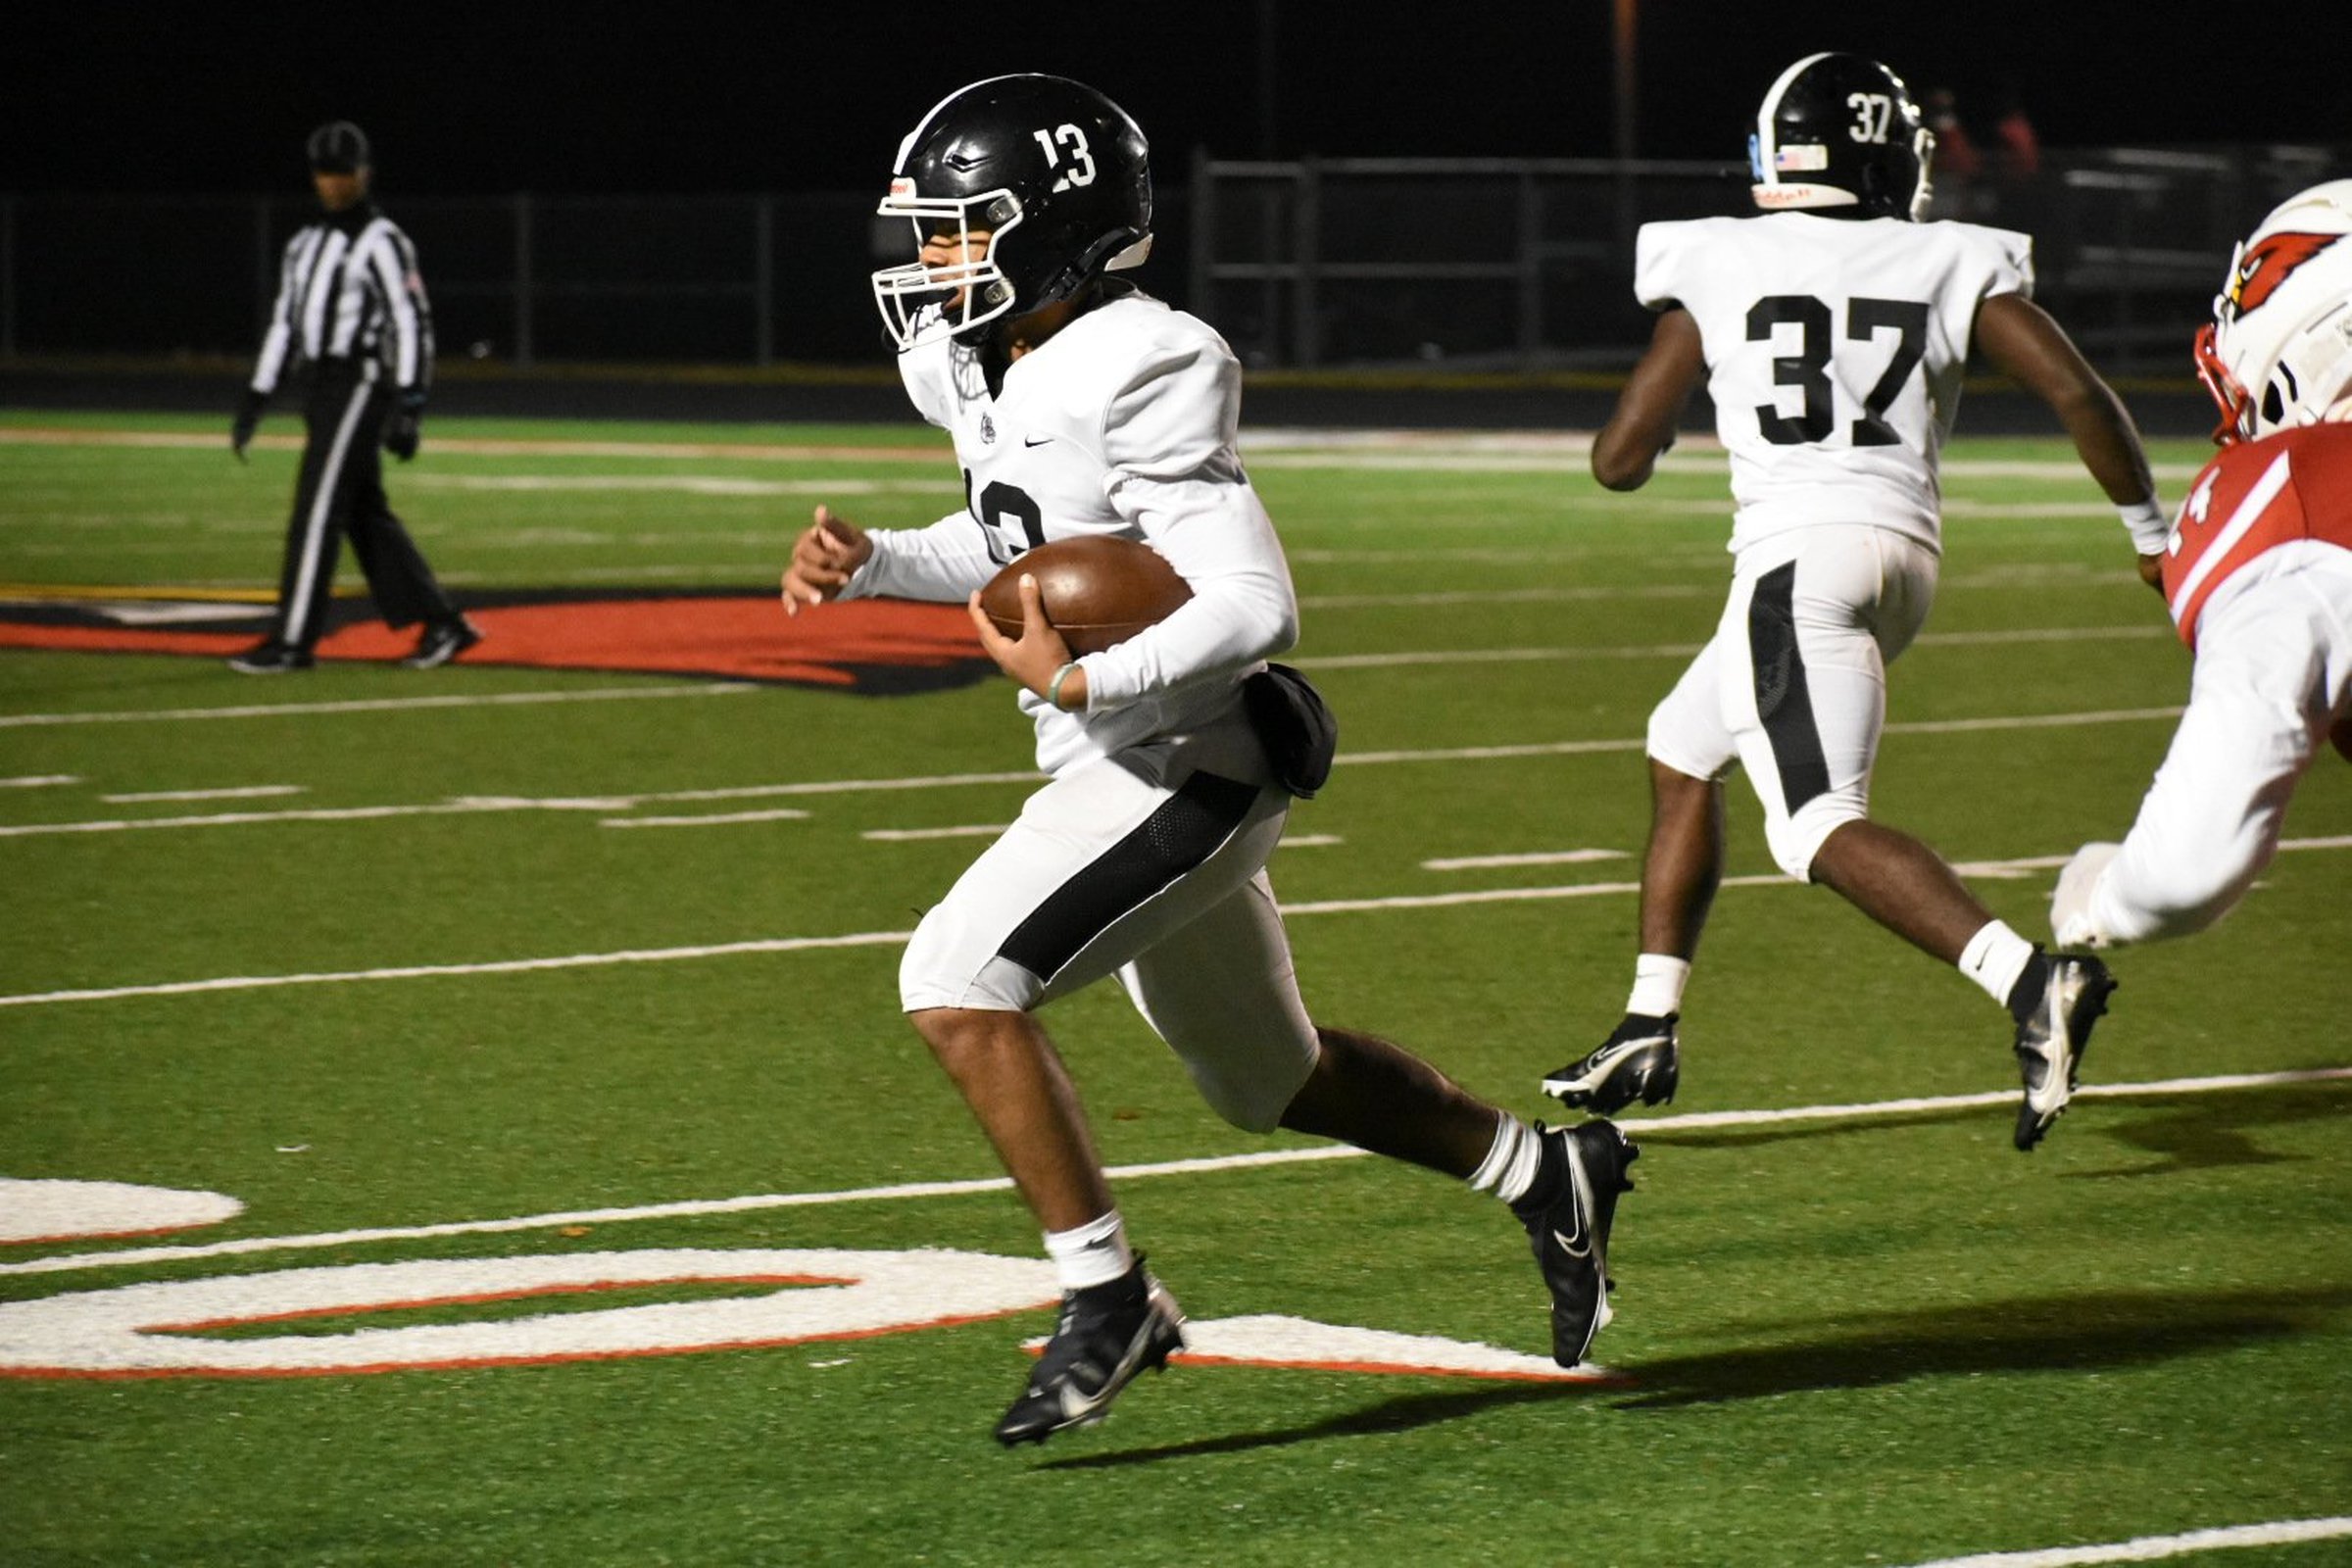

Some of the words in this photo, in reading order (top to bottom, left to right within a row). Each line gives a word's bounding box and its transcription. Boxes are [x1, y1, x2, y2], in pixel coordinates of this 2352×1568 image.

[1847, 93, 1891, 144] 37
[1033, 122, 1098, 194] 13
[1745, 294, 1931, 447] 37
